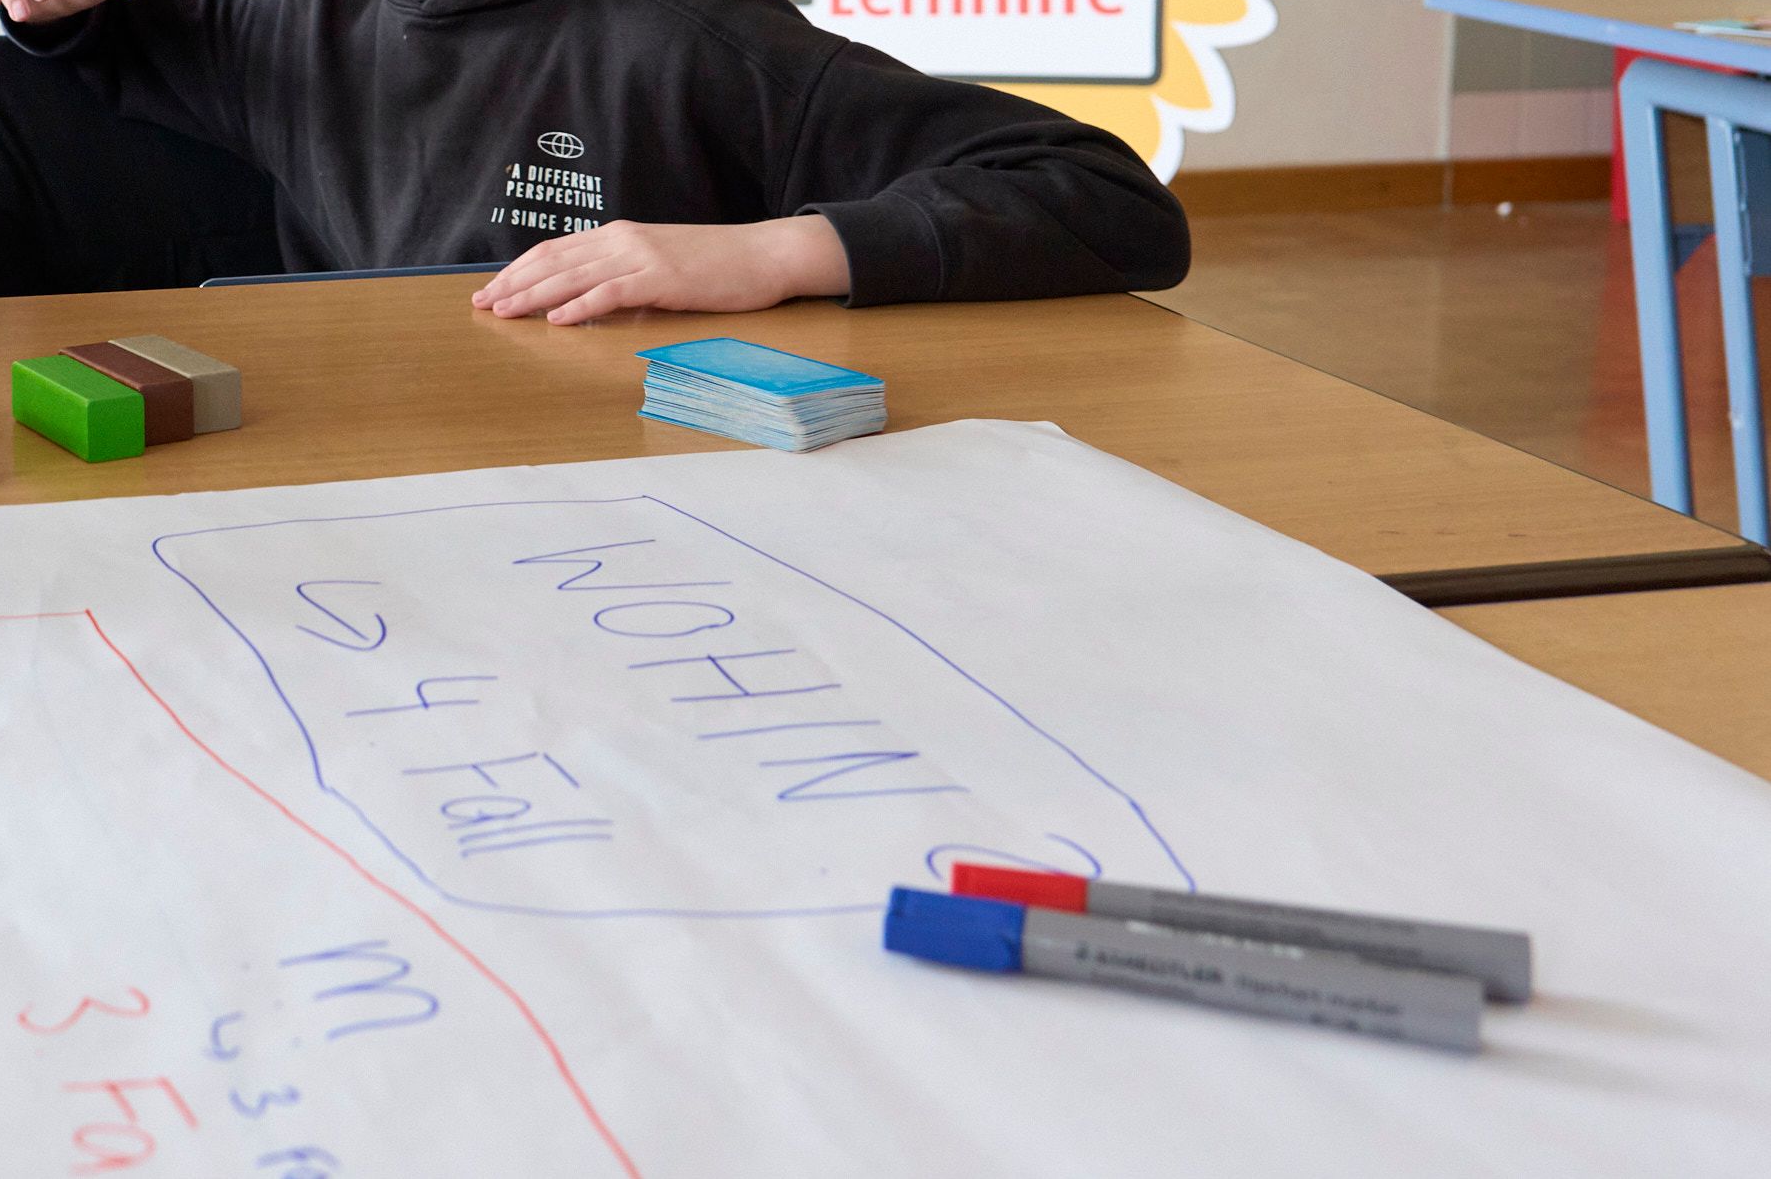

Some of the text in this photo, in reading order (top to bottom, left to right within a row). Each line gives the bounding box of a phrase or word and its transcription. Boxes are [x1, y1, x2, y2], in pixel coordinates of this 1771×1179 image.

[511, 163, 602, 192] A DIFFERENT
[506, 180, 604, 210] PERSPECTIVE
[511, 209, 557, 230] SINCE
